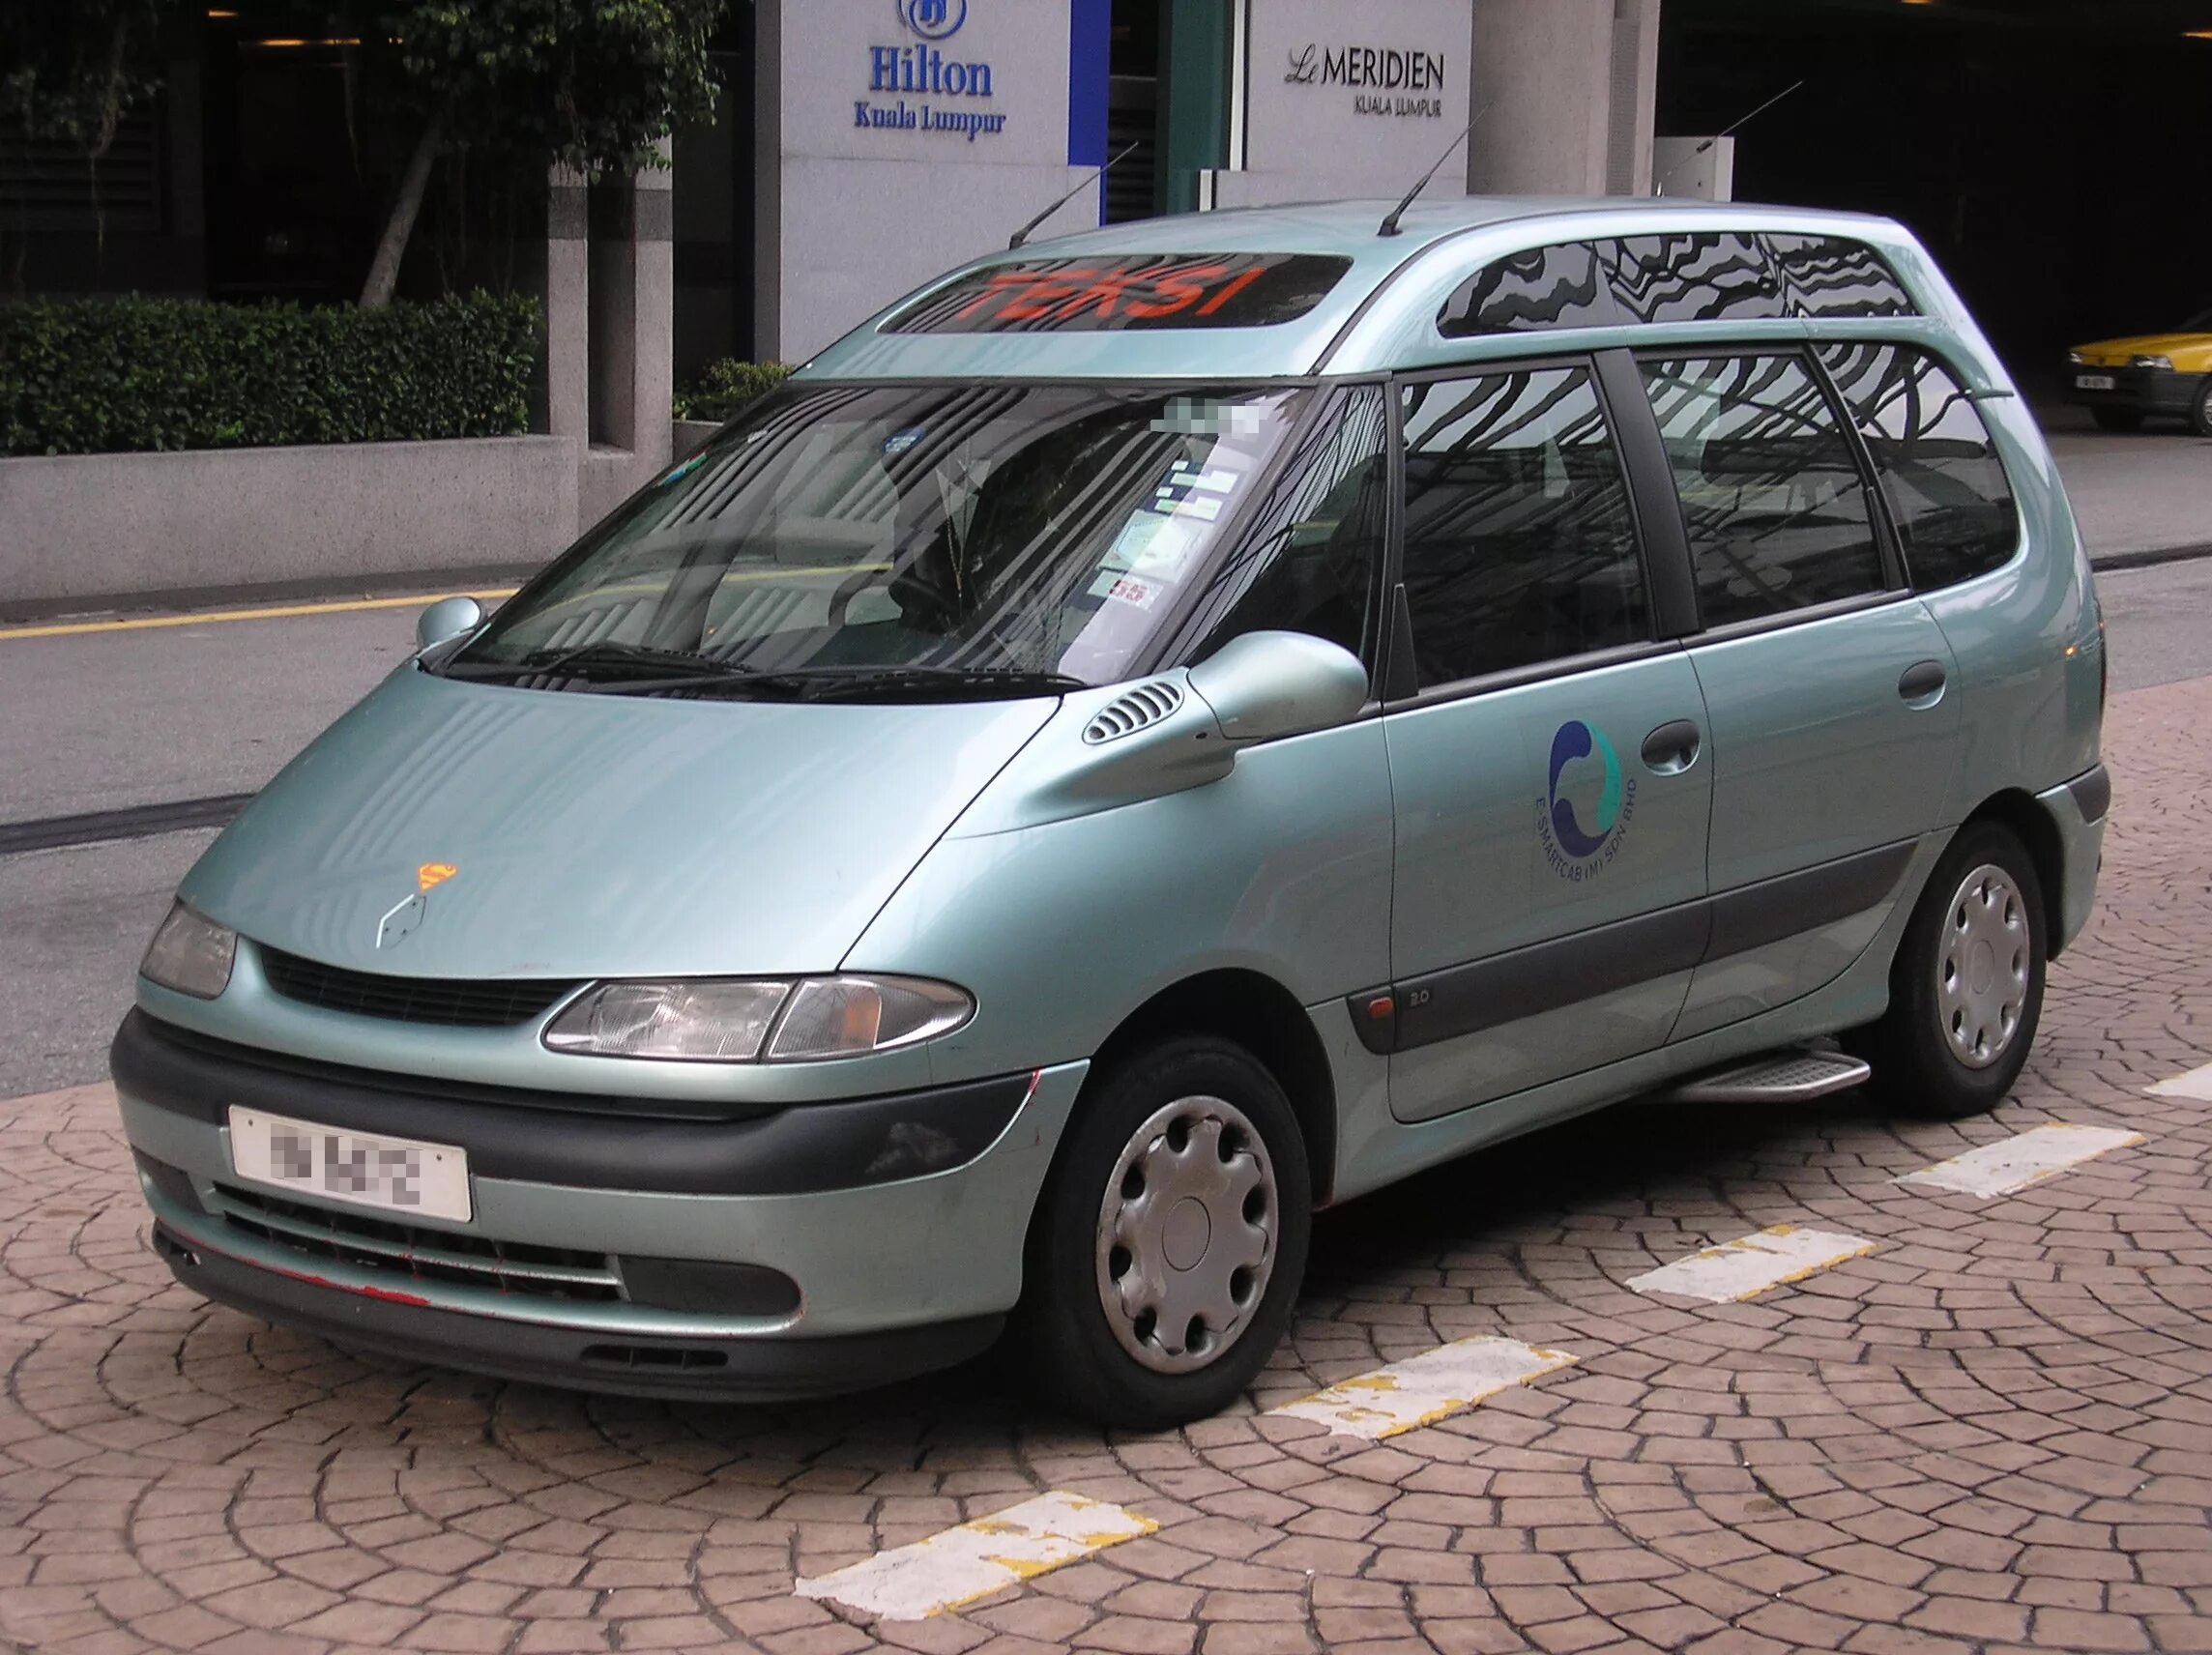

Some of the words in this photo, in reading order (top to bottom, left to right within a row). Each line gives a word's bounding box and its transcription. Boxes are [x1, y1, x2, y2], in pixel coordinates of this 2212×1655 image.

[869, 44, 993, 97] Hilton
[1284, 43, 1319, 84] Le
[1321, 46, 1445, 91] MERIDIEN
[854, 102, 917, 130] Kuala
[920, 105, 1006, 142] Lumpur
[1354, 96, 1392, 116] KUALA
[1395, 98, 1442, 118] LUMPUR
[957, 265, 1267, 321] TEKSI
[1605, 824, 1627, 863] SDN
[1623, 778, 1637, 822] BHD
